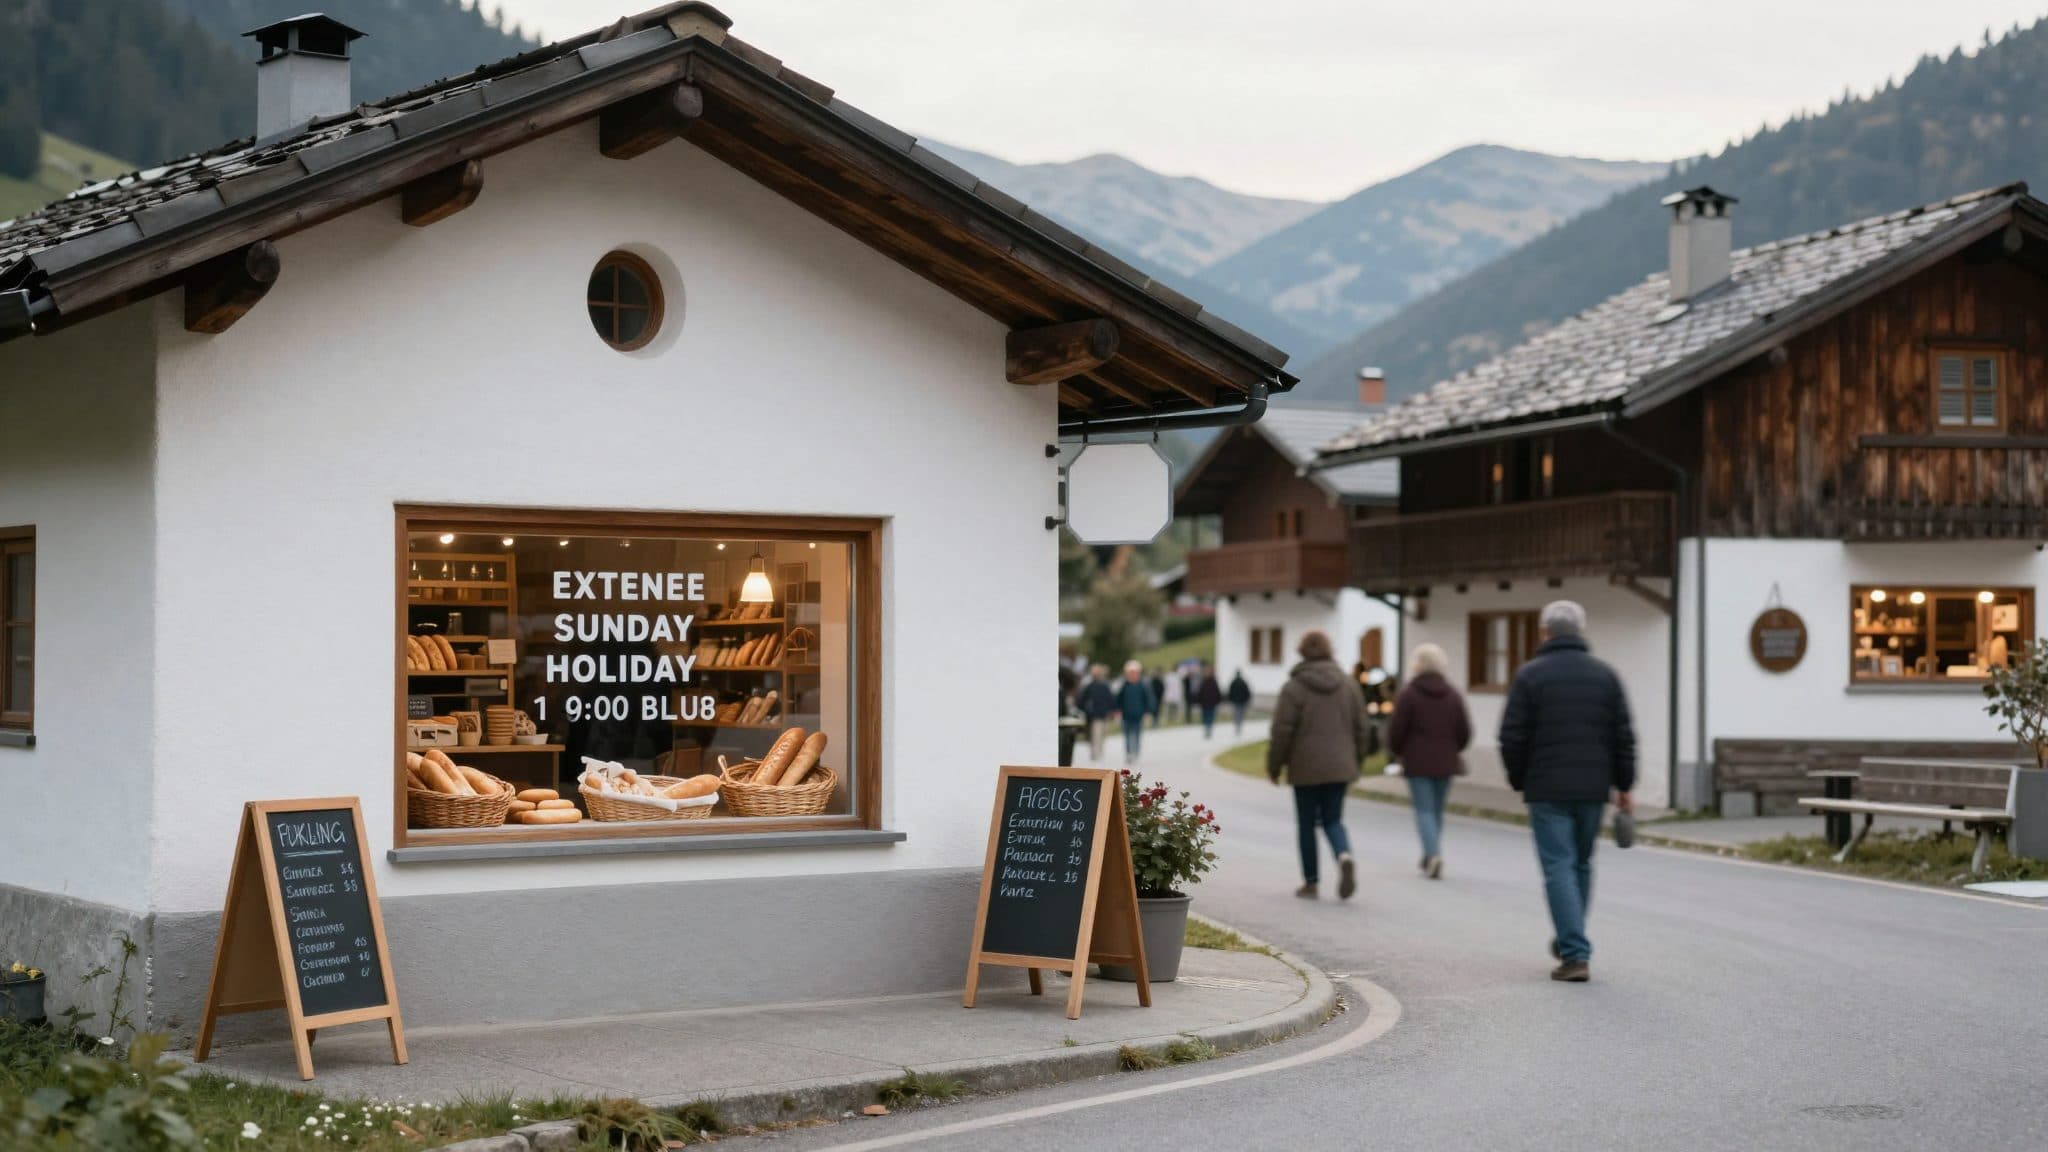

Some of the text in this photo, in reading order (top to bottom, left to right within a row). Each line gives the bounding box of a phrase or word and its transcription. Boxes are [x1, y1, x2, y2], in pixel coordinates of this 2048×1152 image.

[553, 571, 705, 601] EXTENEE
[553, 613, 694, 642] SUNDAY
[546, 654, 697, 683] HOLIDAY
[565, 695, 629, 722] 9:00
